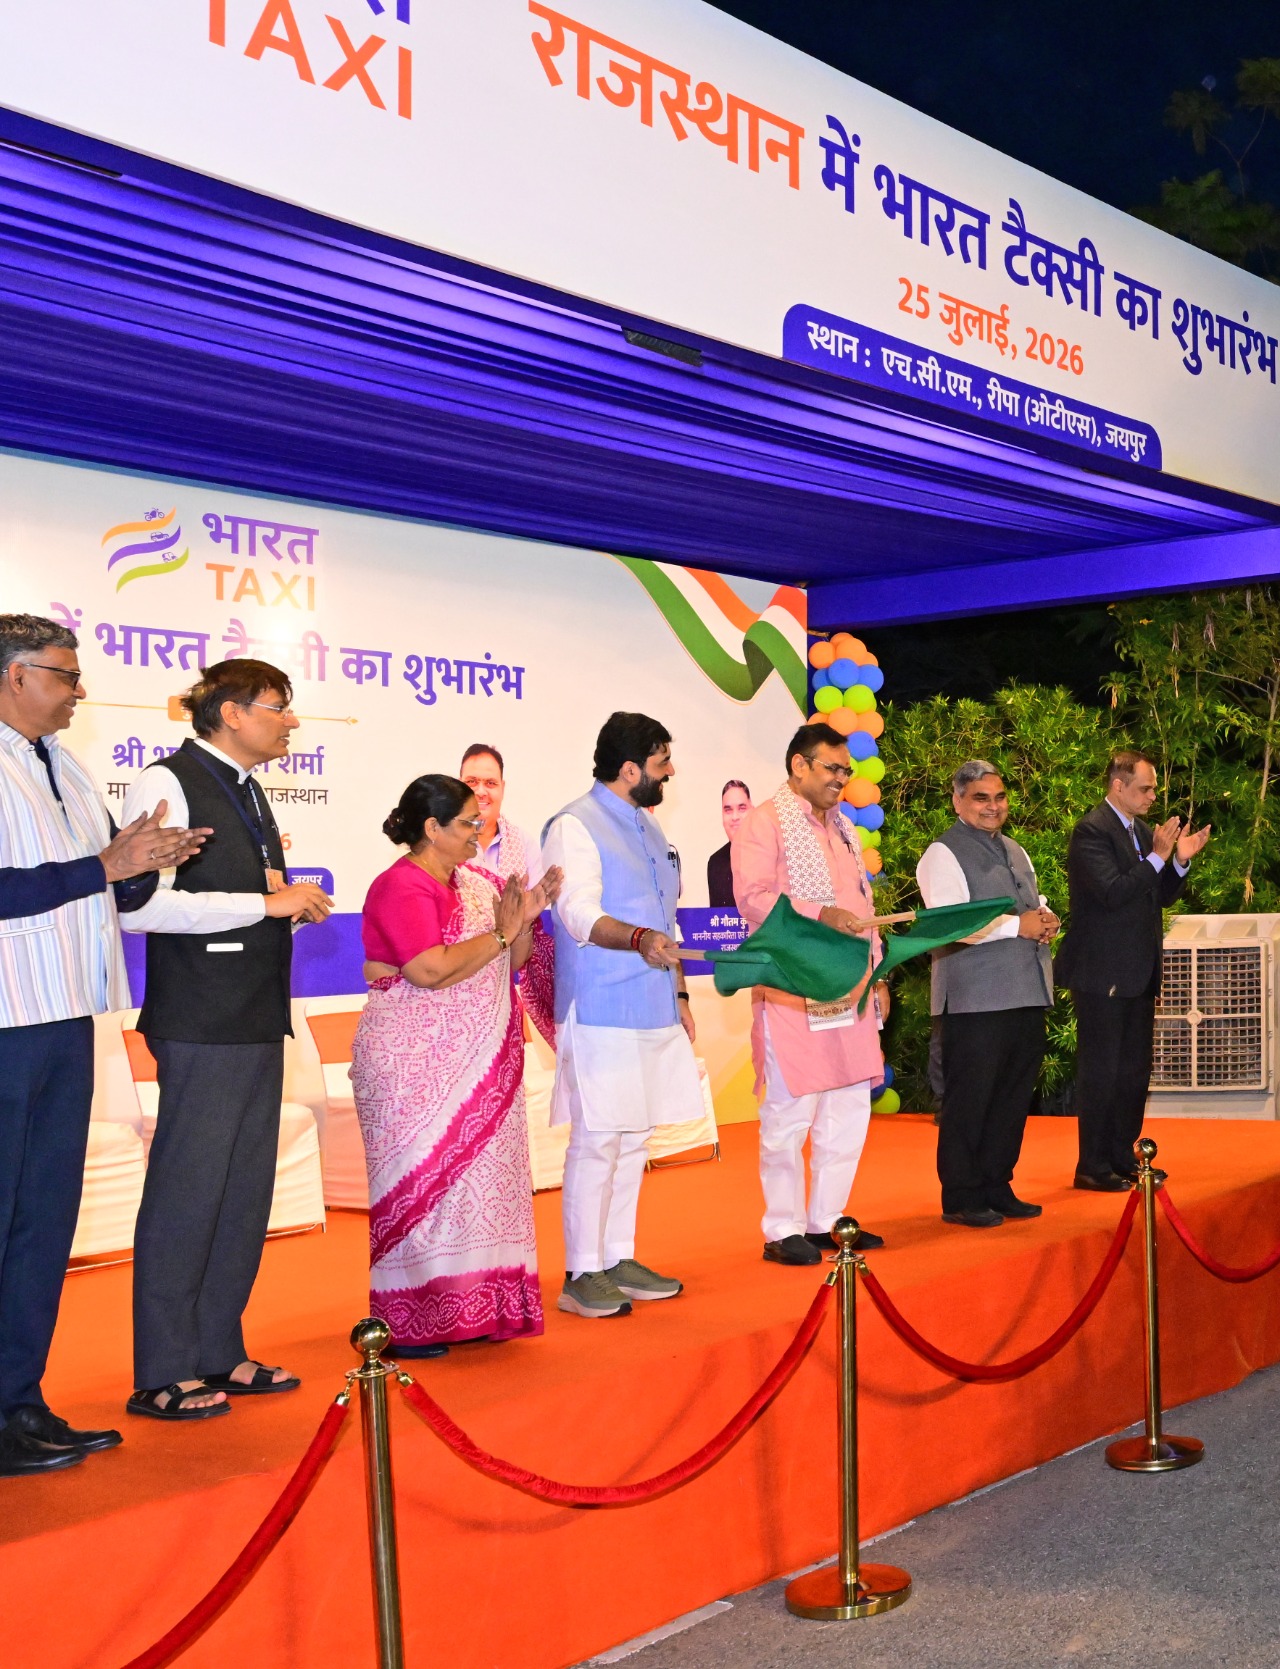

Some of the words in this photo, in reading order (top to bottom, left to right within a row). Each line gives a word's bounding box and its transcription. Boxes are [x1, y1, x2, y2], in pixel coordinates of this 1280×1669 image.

[529, 0, 805, 190] राजस्थान
[819, 114, 861, 215] में
[874, 164, 990, 270] भारत
[1002, 197, 1104, 317] टैक्सी
[1114, 271, 1161, 340] का
[1172, 298, 1278, 384] शुभारंभ
[898, 277, 930, 320] 25
[939, 292, 1017, 360] जुलाई,
[1025, 327, 1084, 375] 2026
[987, 377, 1020, 417] रीपा
[1105, 422, 1147, 462] जयपुर
[202, 512, 319, 565] भारत
[206, 563, 315, 611] TAXI
[95, 623, 210, 671] भारत
[340, 647, 392, 687] का
[403, 652, 525, 705] शुभारंभ
[112, 737, 145, 768] श्री
[277, 746, 324, 775] शर्मा
[264, 787, 328, 805] ाजस्थान
[710, 915, 719, 927] श्री
[720, 914, 739, 927] गौतम
